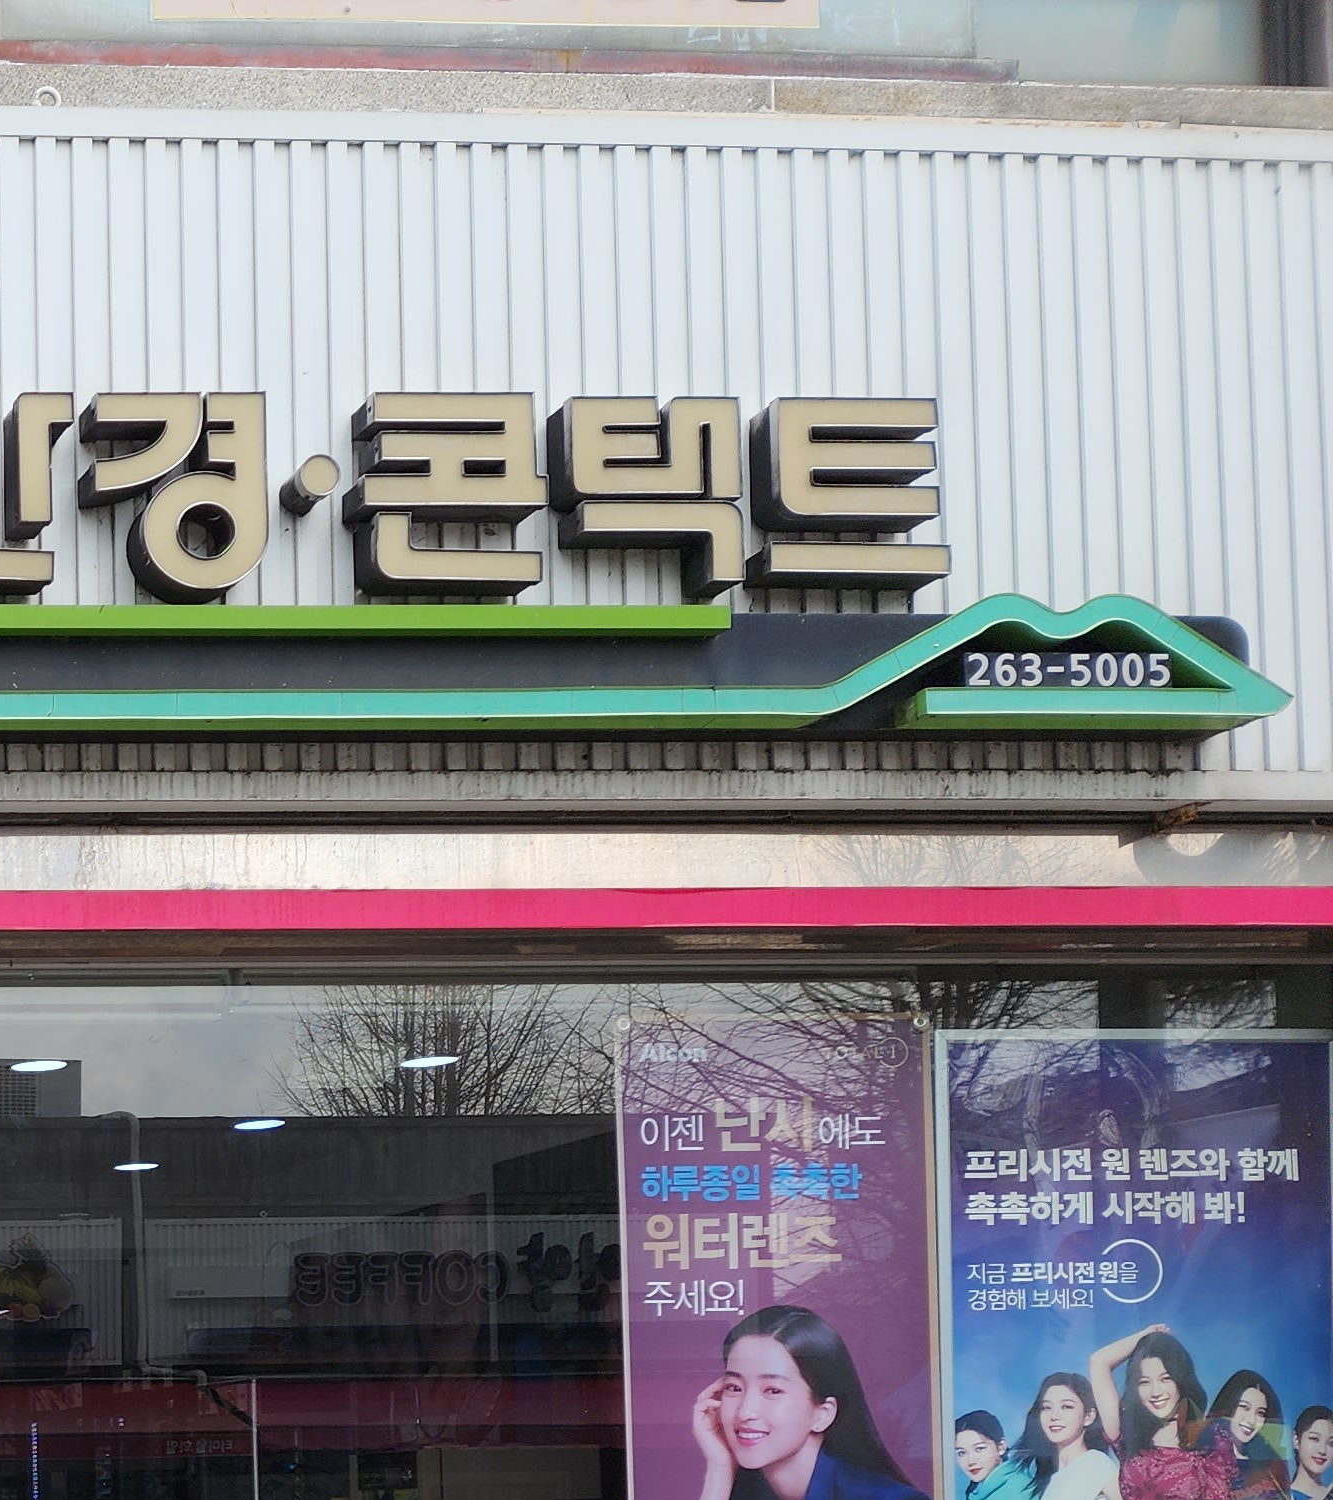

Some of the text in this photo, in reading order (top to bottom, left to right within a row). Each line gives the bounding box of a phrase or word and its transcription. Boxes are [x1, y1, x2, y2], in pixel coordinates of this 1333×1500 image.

[967, 651, 1172, 690] 263-5005
[639, 1043, 707, 1063] Alcon
[640, 1115, 704, 1151] 이젠
[640, 1162, 862, 1202] 하루종일 촉촉한
[964, 1147, 1299, 1182] 프리시전 원 렌즈와 함께
[964, 1190, 1246, 1226] 촉촉하게 시작해 봐!
[643, 1213, 842, 1270] 워터렌즈
[967, 1261, 1138, 1285] 지금 프리시전 원을
[643, 1279, 745, 1316] 주세요!
[968, 1288, 1094, 1311] 경험해 보세요!
